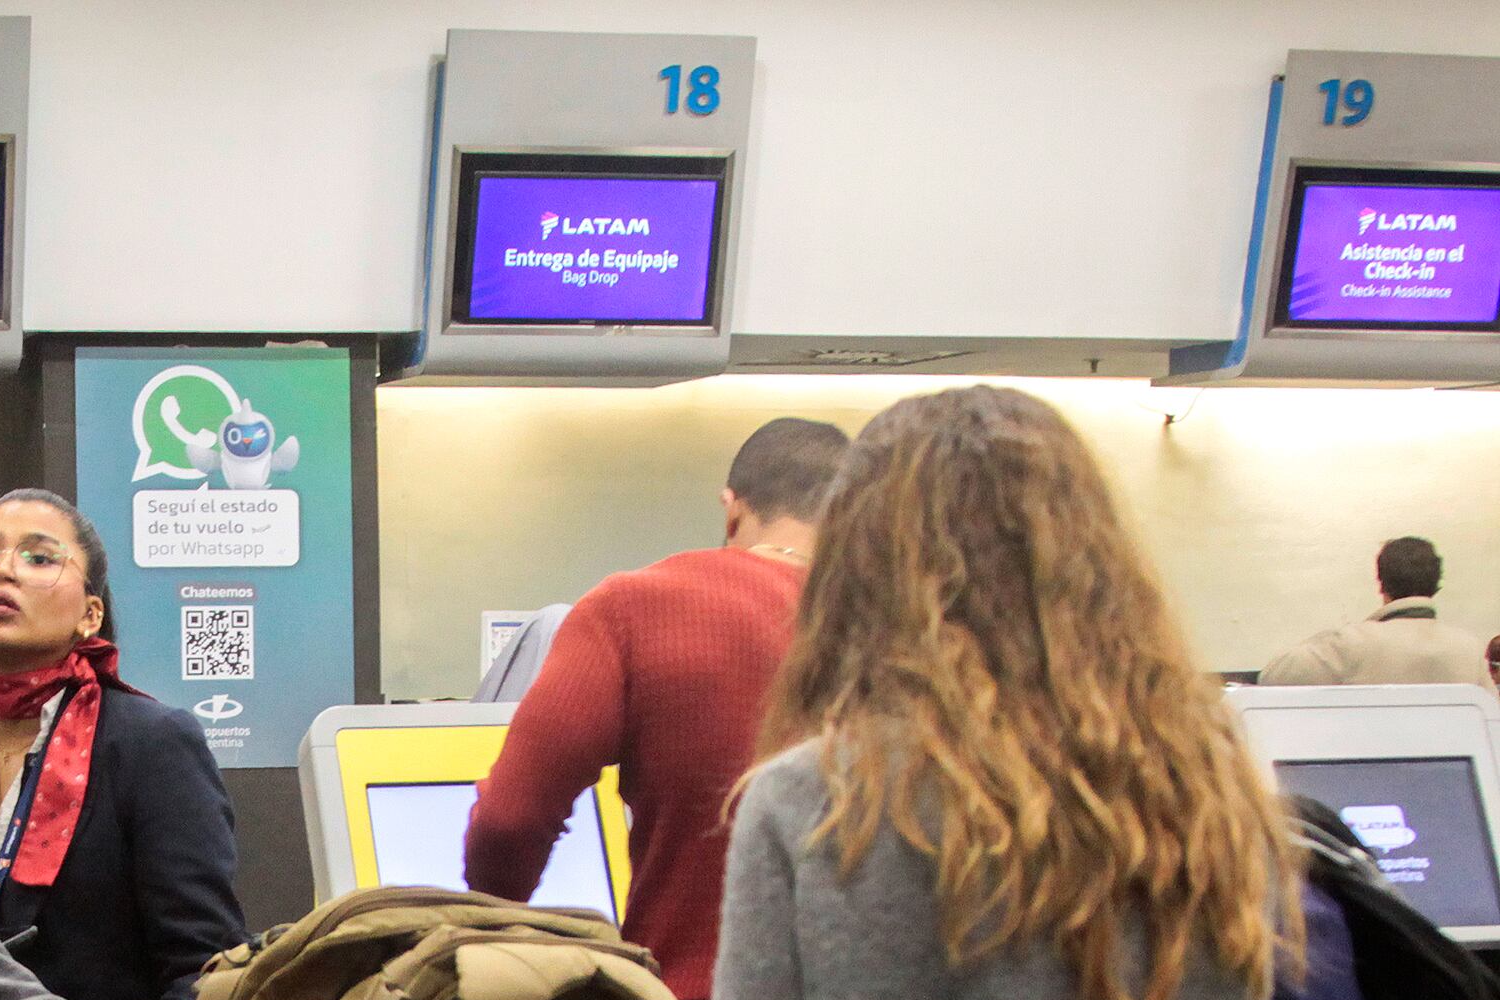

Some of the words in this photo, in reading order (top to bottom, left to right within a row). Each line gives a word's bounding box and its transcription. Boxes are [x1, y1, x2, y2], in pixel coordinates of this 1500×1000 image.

[659, 64, 721, 116] 18
[1318, 79, 1375, 126] 19
[562, 217, 650, 235] LATAM
[1377, 213, 1457, 231] LATAM
[504, 248, 574, 272] Entrega
[577, 249, 600, 267] de
[603, 249, 679, 273] Equipaje
[1340, 242, 1423, 261] Asistencia
[1424, 248, 1446, 262] en
[1447, 243, 1465, 262] el
[562, 270, 586, 287] Bag
[589, 270, 619, 287] Drop
[1364, 261, 1436, 280] Check-in
[1341, 283, 1391, 297] Check-in
[1391, 284, 1453, 298] Assistance
[148, 499, 196, 516] Seguí
[200, 499, 215, 513] el
[220, 499, 278, 513] estado
[148, 521, 169, 534] de
[173, 521, 191, 534] tu
[196, 520, 244, 534] vuelo
[148, 544, 176, 558] por
[181, 541, 264, 558] Whatsapp
[180, 586, 253, 598] Chateemos
[204, 727, 251, 739] opuertos
[206, 738, 244, 750] gentina
